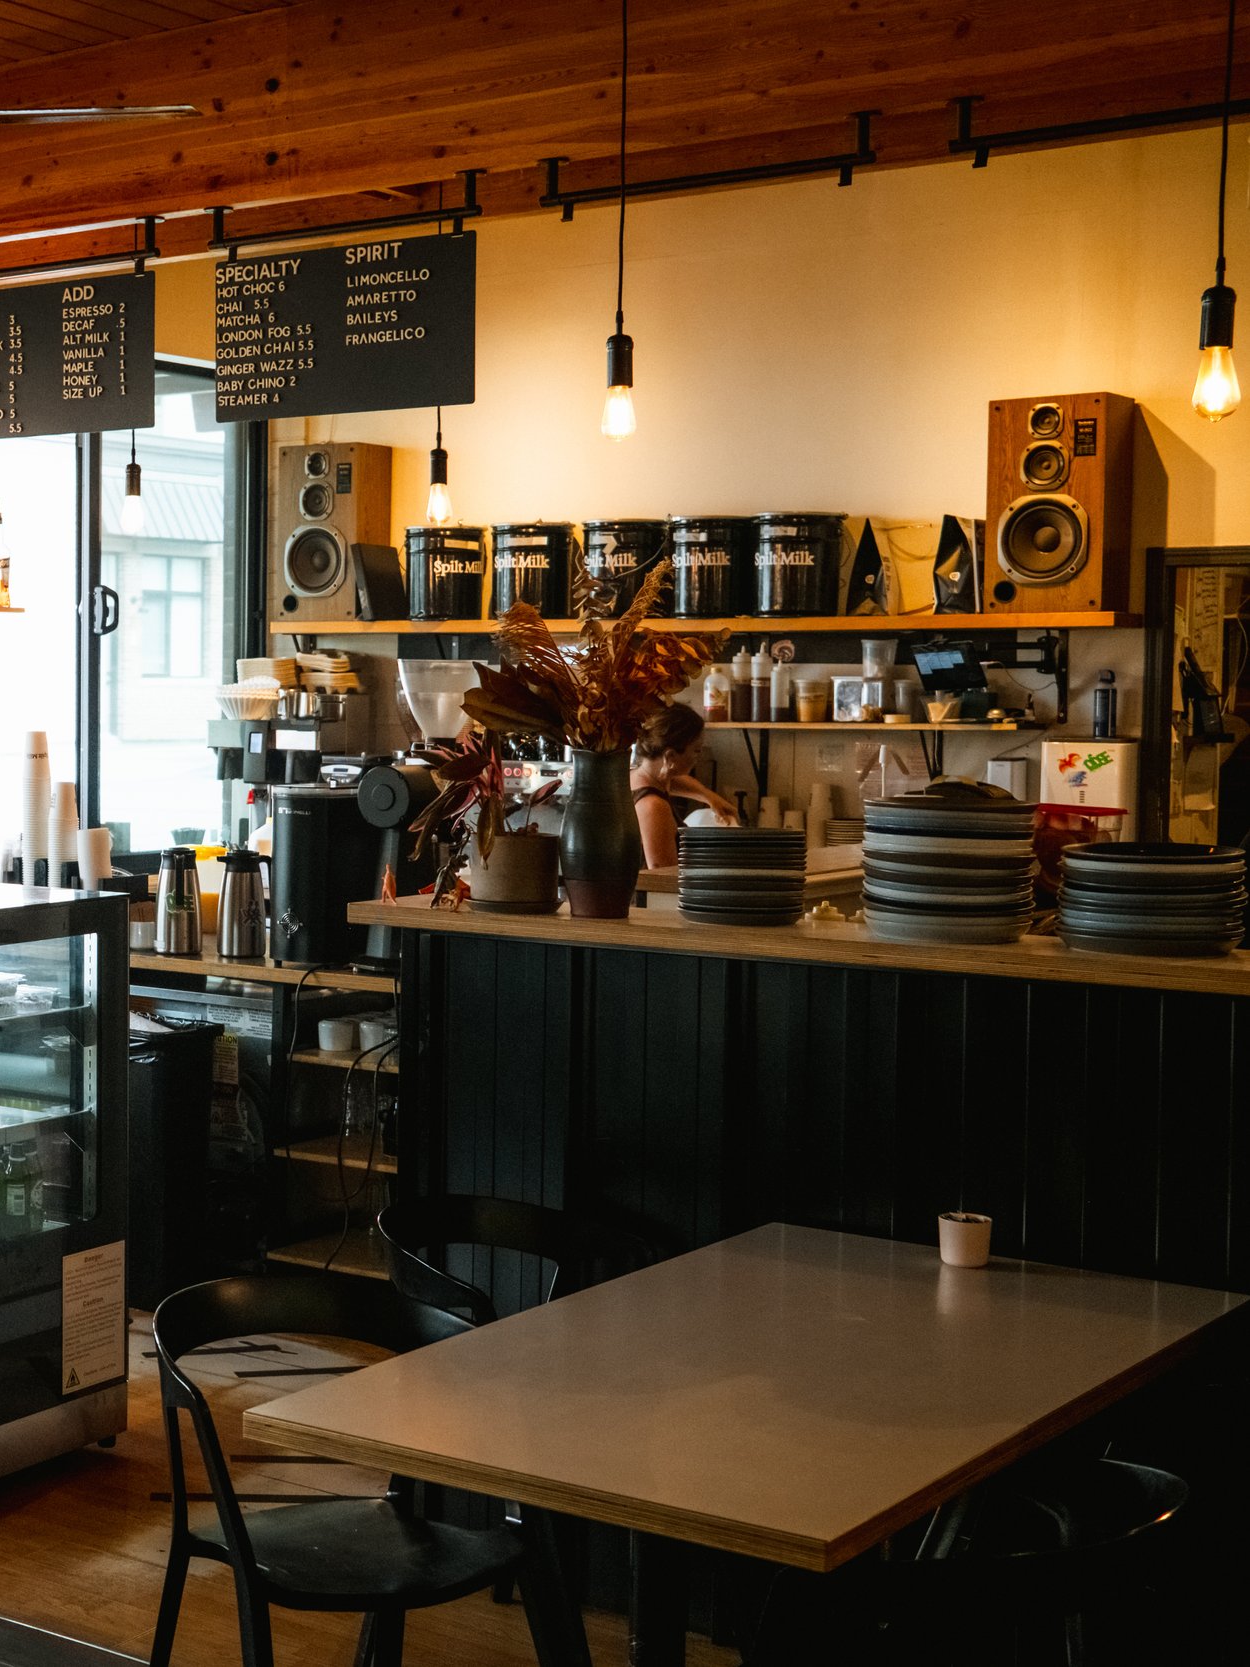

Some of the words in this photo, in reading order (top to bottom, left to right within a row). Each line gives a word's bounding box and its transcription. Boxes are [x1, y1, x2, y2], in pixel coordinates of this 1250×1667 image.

[345, 242, 403, 265] SPIRIT
[216, 259, 301, 284] SPECIALTY
[347, 269, 430, 287] LIMONCELLO
[62, 286, 94, 303] ADD
[218, 286, 239, 299] HOT
[243, 282, 274, 295] CHOC
[278, 281, 285, 292] 6
[347, 290, 416, 306] AMARETTO
[63, 305, 113, 318] ESPRESSO
[119, 304, 125, 312] 2
[216, 301, 242, 314] CHAI
[254, 299, 269, 310] 5.5
[10, 315, 15, 324] 3
[217, 314, 261, 327] MATCHA
[269, 312, 275, 323] 6
[347, 310, 398, 325] BAILEYS
[9, 327, 21, 336] 3.5
[63, 320, 95, 332] DECAF
[63, 335, 81, 345] ALT
[85, 333, 109, 343] MILK
[120, 333, 125, 341] 1
[217, 329, 263, 344] LONDON
[268, 326, 290, 338] FOG
[297, 325, 311, 335] 5.5
[346, 327, 425, 345] FRANGELICO
[9, 339, 22, 348] 3.5
[216, 345, 261, 359] GOLDEN
[264, 341, 295, 354] CHAI
[298, 340, 314, 351] 5.5
[9, 353, 23, 363] 4.5
[63, 347, 104, 360] VANILLA
[120, 346, 124, 355] 1
[9, 366, 23, 375] 4.5
[63, 362, 94, 373] MAPLE
[120, 361, 124, 369] 1
[217, 362, 255, 376] GINGER
[261, 359, 293, 371] WAZZ
[298, 358, 314, 369] 5.5
[9, 382, 14, 391] 5
[63, 376, 98, 386] HONEY
[120, 373, 124, 382] 1
[217, 380, 243, 392] BABY
[248, 377, 285, 389] CHINO
[290, 376, 296, 387] 2
[9, 395, 15, 403] 5
[63, 389, 83, 399] SIZE
[89, 387, 103, 397] UP
[121, 386, 126, 395] 1
[218, 394, 268, 406] STEAMER
[273, 393, 280, 404] 4
[10, 410, 15, 419] 5
[9, 424, 22, 433] 5.5
[495, 555, 516, 572] Spilt
[519, 555, 549, 568] Milk
[606, 553, 638, 567] Milk
[697, 553, 730, 565] Milk
[755, 551, 777, 569] Spilt
[781, 551, 814, 565] Milk
[434, 560, 463, 576] Spilt
